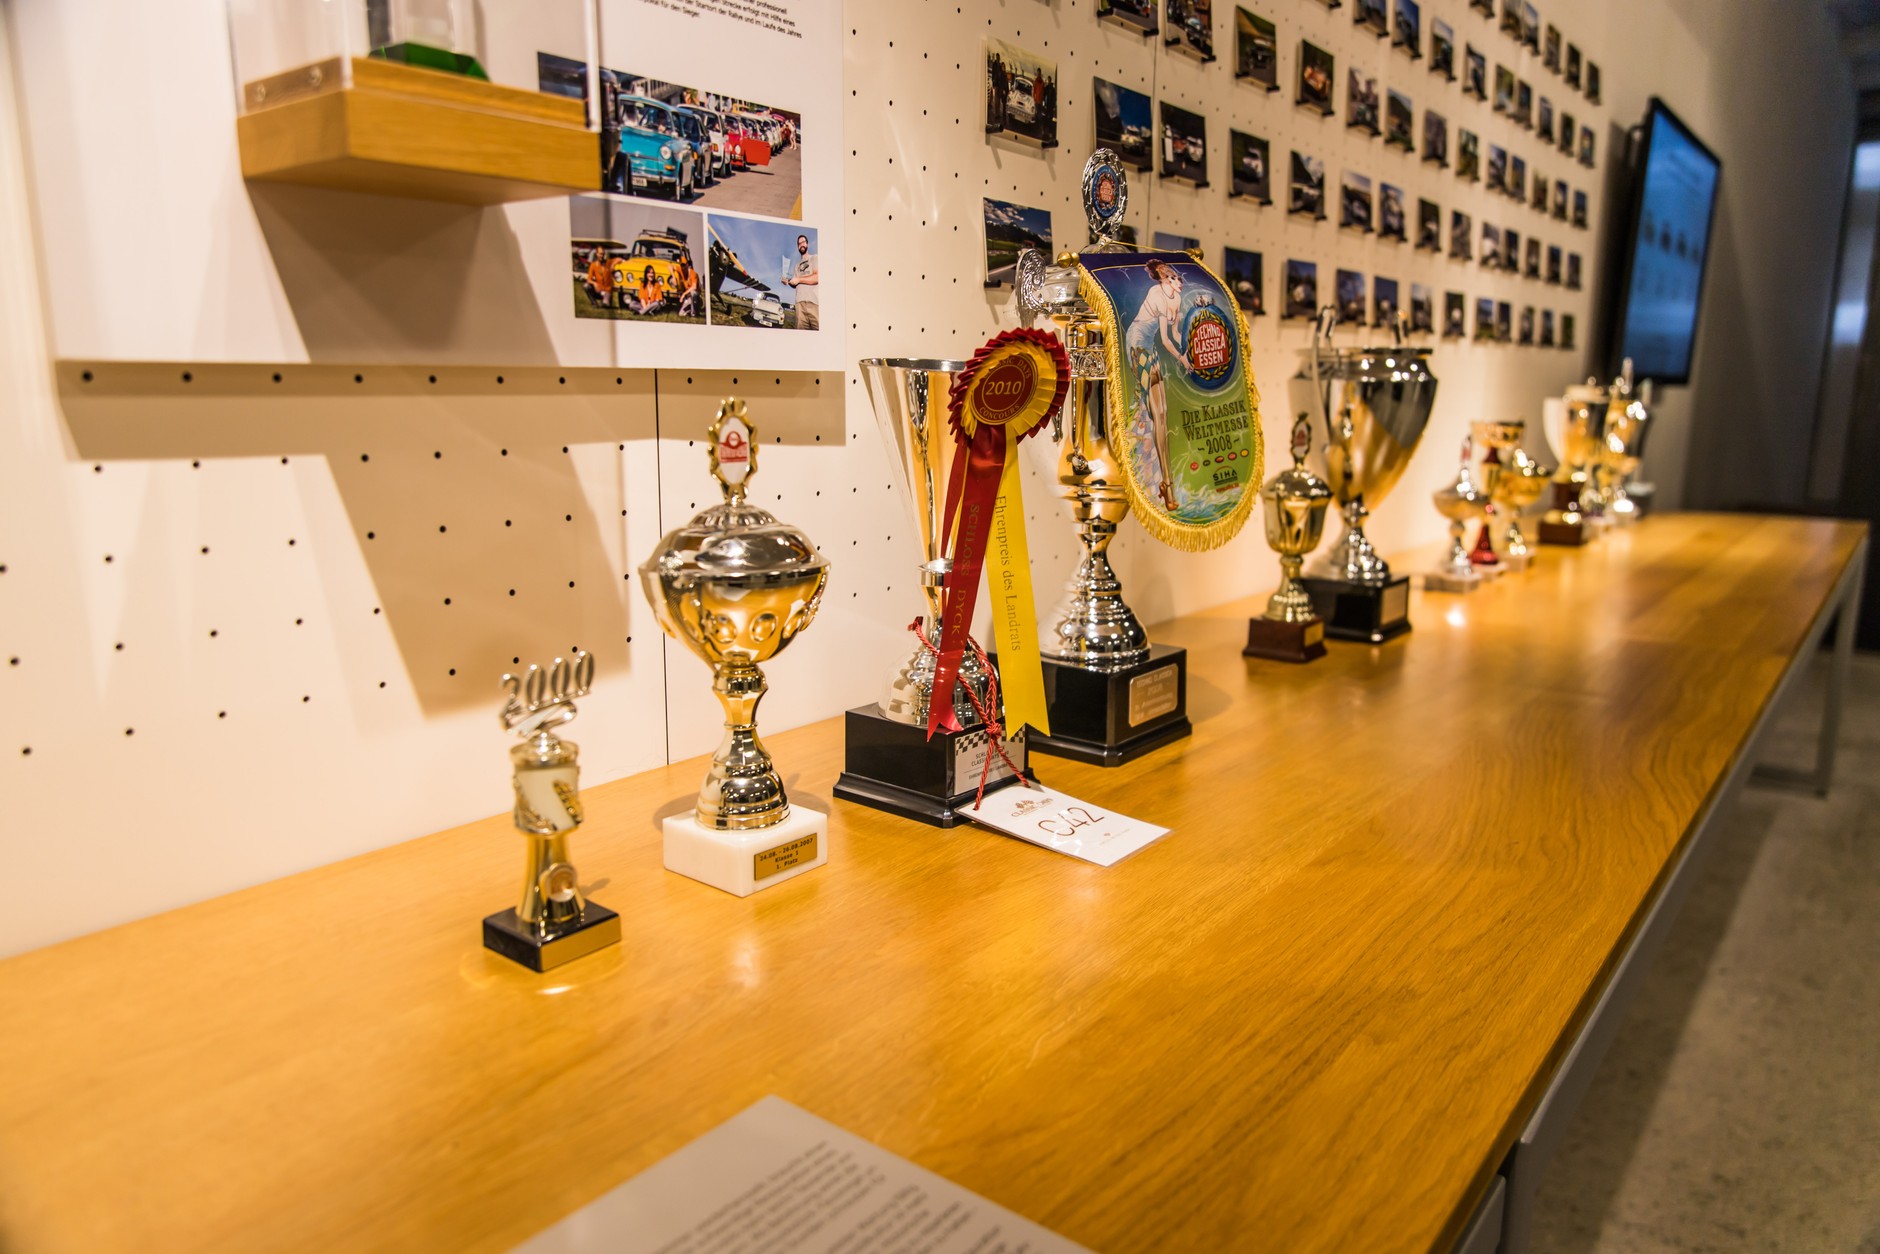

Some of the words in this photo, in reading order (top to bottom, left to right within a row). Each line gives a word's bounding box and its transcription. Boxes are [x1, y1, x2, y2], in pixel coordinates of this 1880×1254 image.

[1194, 332, 1226, 354] CLASSICA
[1199, 350, 1224, 366] ESSEN
[1017, 360, 1032, 379] DAYS
[985, 381, 1022, 396] 2010
[979, 404, 1020, 420] CONCOURS
[1212, 470, 1237, 480] SIHA
[961, 504, 980, 576] SCHLOSS
[995, 496, 1012, 566] Ehrenpreis
[1002, 570, 1014, 591] des
[952, 590, 966, 635] DYCK
[1006, 594, 1022, 652] Landrats
[500, 650, 595, 725] 2000
[760, 852, 778, 862] 24.08.
[782, 838, 813, 853] 26.08.2007
[775, 854, 792, 862] Klasse
[784, 858, 798, 866] Platz
